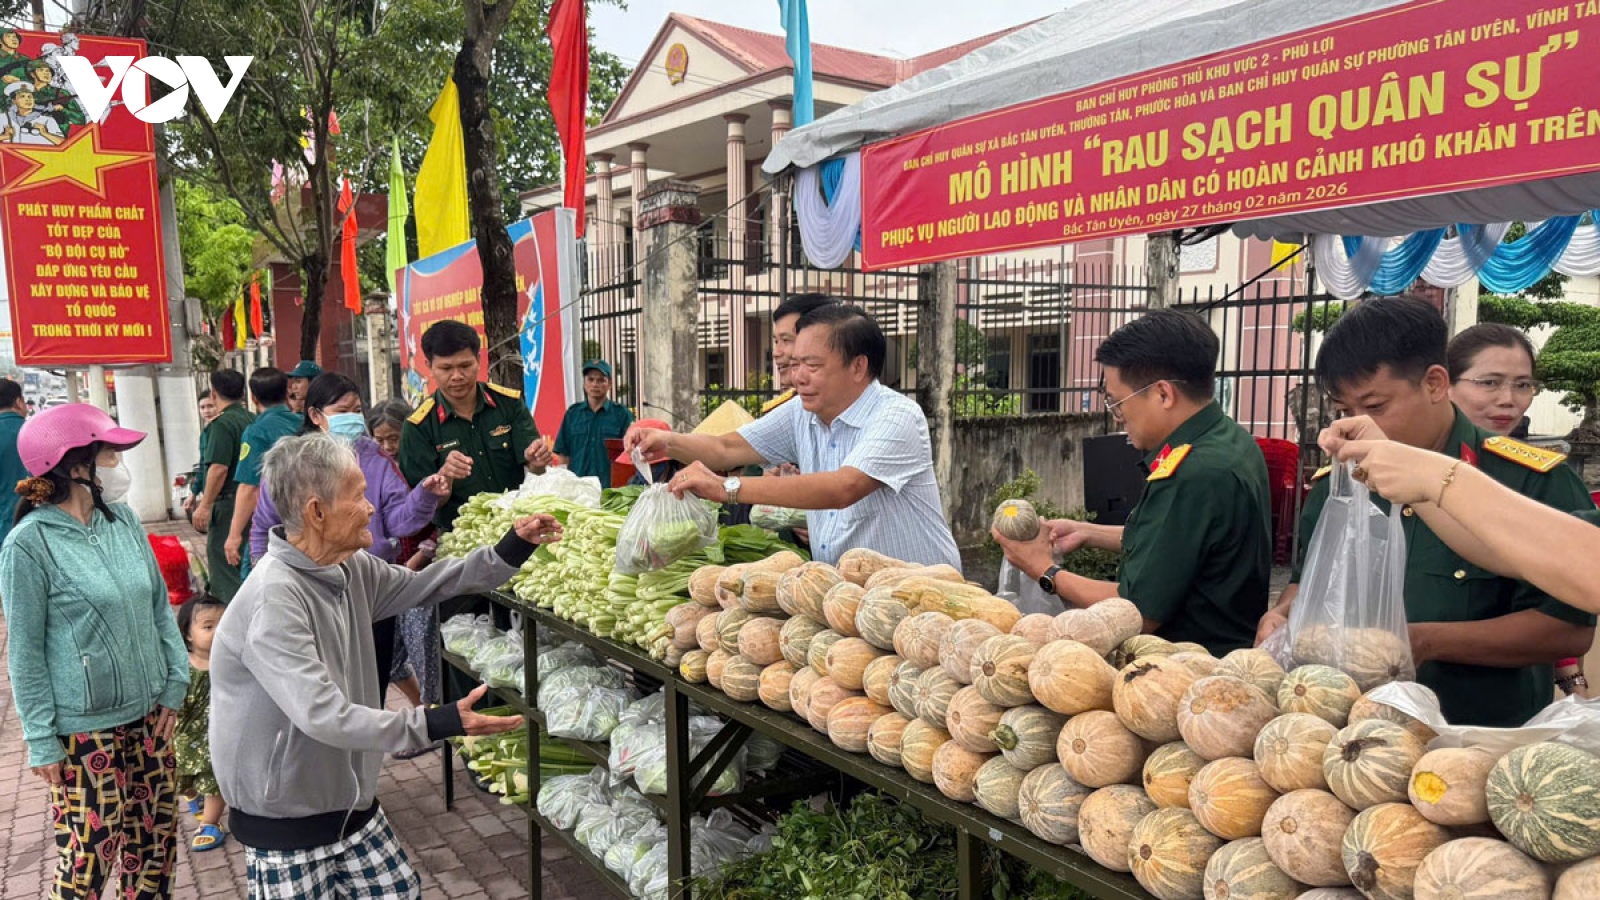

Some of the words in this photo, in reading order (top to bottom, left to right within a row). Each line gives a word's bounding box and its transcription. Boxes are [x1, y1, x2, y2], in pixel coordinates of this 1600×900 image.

[1076, 96, 1097, 112] BAN
[1099, 87, 1116, 106] CHỈ
[1118, 85, 1138, 101] HUY
[1141, 75, 1179, 97] PHÒNG
[1182, 67, 1202, 86] THỦ
[1206, 64, 1230, 81] KHU
[1234, 56, 1258, 75] VỰC
[1261, 53, 1270, 68] 2
[1313, 36, 1335, 55] LỢI
[903, 160, 920, 172] BAN
[934, 150, 950, 164] HUY
[951, 144, 973, 160] QUÂN
[975, 140, 987, 156] SỰ
[1021, 129, 1038, 144] TÂN
[1069, 112, 1107, 133] THƯỜNG
[1135, 98, 1172, 118] PHƯỚC
[1200, 87, 1215, 103] VÀ
[1218, 82, 1244, 99] BAN
[1248, 71, 1269, 92] CHỈ
[1272, 68, 1298, 86] HUY
[1301, 59, 1340, 80] QUÂN
[1344, 51, 1364, 71] SỰ
[1367, 38, 1429, 65] PHƯỜNG
[1434, 29, 1466, 50] TÂN
[1526, 6, 1569, 30] VĨNH
[949, 160, 992, 205] MÔ
[1001, 150, 1073, 196] HÌNH
[1084, 128, 1169, 177] “RAU
[1181, 102, 1292, 164] SẠCH
[1308, 71, 1445, 141] QUÂN
[881, 226, 914, 248] PHỤC
[917, 222, 934, 243] VỤ
[937, 211, 980, 238] NGƯỜI
[983, 208, 1011, 230] LAO
[1015, 201, 1059, 228] ĐỘNG
[1063, 193, 1085, 218] VÀ
[1090, 185, 1141, 213] NHÂN
[1146, 177, 1187, 205] DÂN
[1192, 169, 1220, 197] CÓ
[1227, 160, 1289, 192] HOÀN
[1295, 147, 1364, 181] CẢNH
[1371, 133, 1426, 169] KHÓ
[1435, 121, 1517, 159] KHĂN
[17, 201, 48, 217] PHÁT
[51, 204, 76, 218] HUY
[1063, 222, 1083, 236] Bắc
[1086, 219, 1106, 233] Tân
[1147, 208, 1179, 225] ngày
[1181, 204, 1198, 218] 27
[1202, 199, 1241, 215] tháng
[1245, 195, 1264, 209] 02
[1267, 190, 1301, 206] năm
[1306, 182, 1348, 201] 2026
[46, 221, 69, 238] TỐT
[72, 225, 94, 240] ĐẸP
[97, 224, 121, 240] CỦA
[66, 243, 87, 260] ĐỘI
[89, 246, 106, 260] CỤ
[36, 263, 60, 278] ĐÁP
[63, 264, 88, 278] ỨNG
[90, 263, 111, 278] YÊU
[114, 262, 138, 279] CẦU
[30, 283, 53, 297] XÂY
[91, 283, 107, 298] VÀ
[109, 284, 133, 298] BẢO
[135, 284, 150, 301] VỆ
[84, 301, 117, 318] QUỐC
[32, 324, 72, 337] TRONG
[74, 322, 102, 337] THỜI
[122, 322, 145, 337] MỚI
